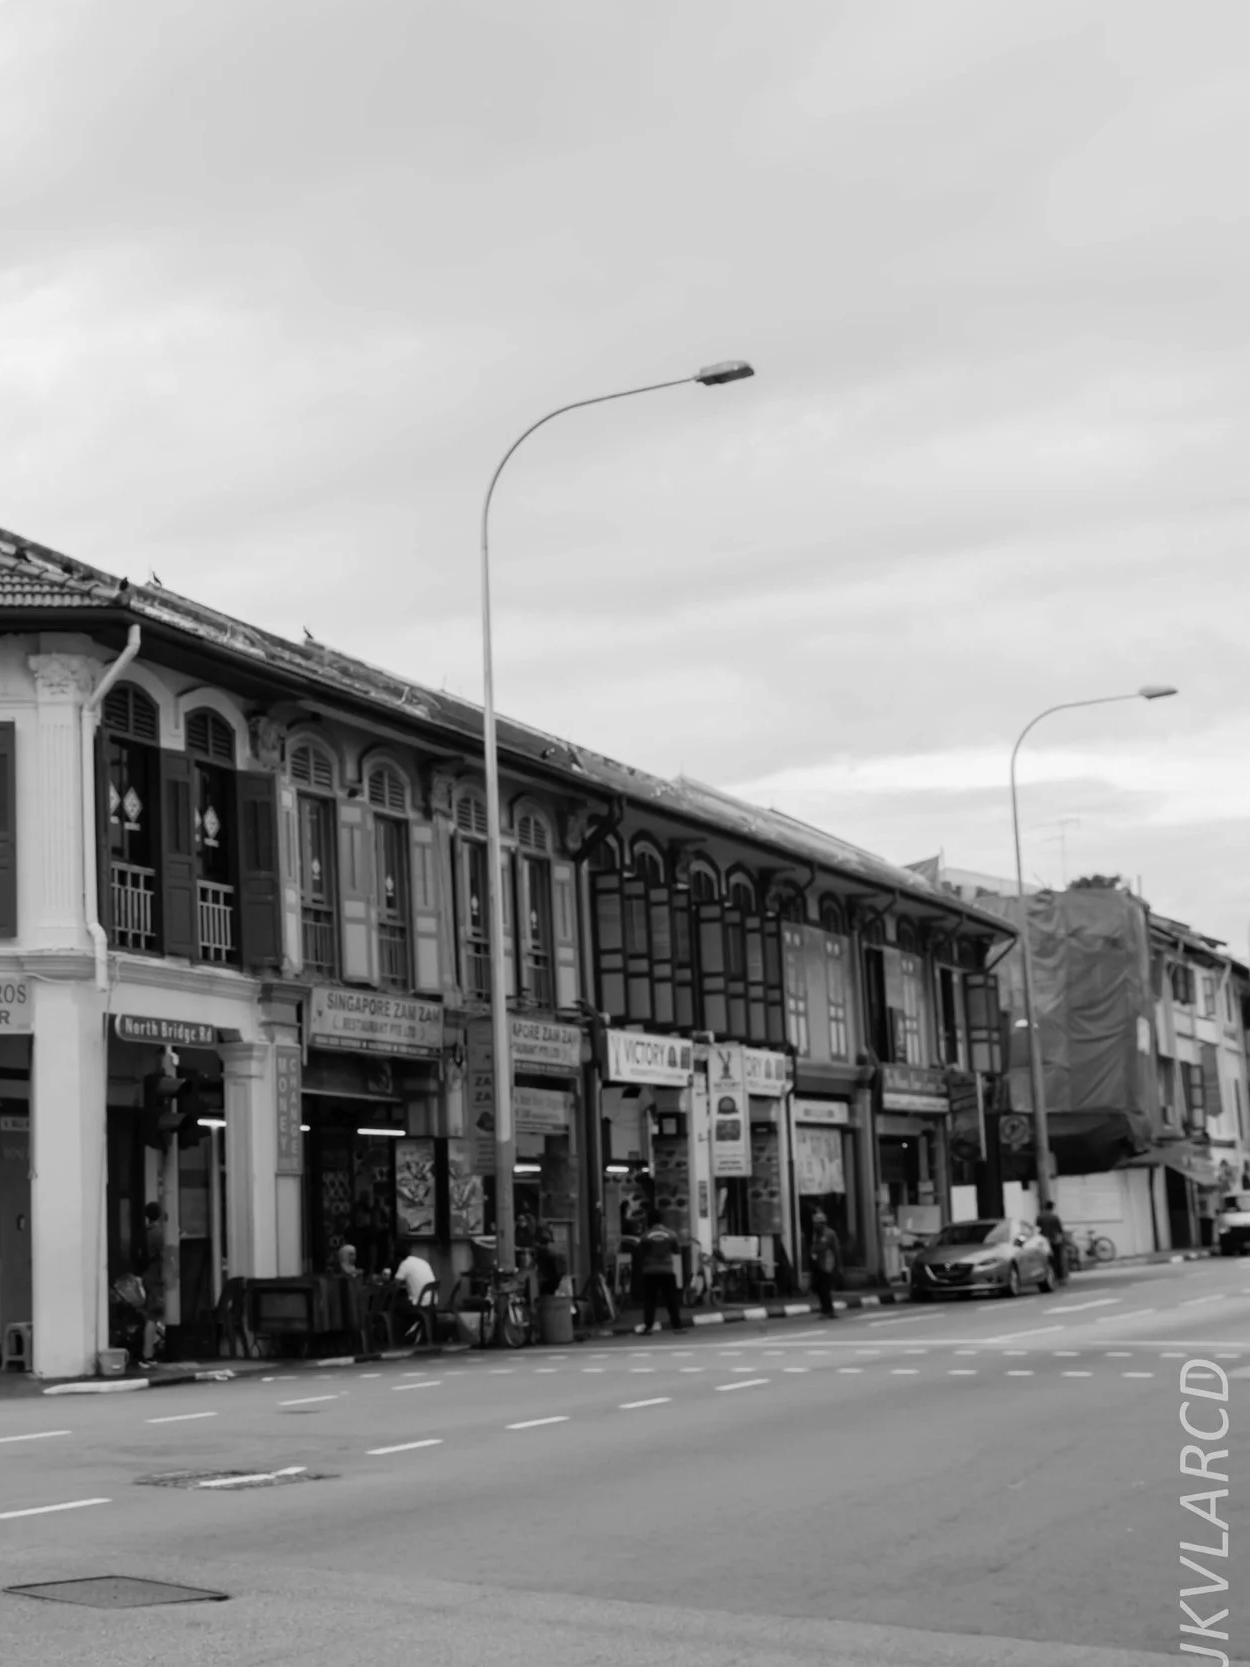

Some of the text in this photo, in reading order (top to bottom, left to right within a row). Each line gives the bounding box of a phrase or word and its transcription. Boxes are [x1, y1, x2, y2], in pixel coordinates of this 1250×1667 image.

[327, 991, 390, 1017] SINGAPORE
[125, 1017, 212, 1044] North Bridge Rd
[624, 1038, 665, 1067] VICTORY
